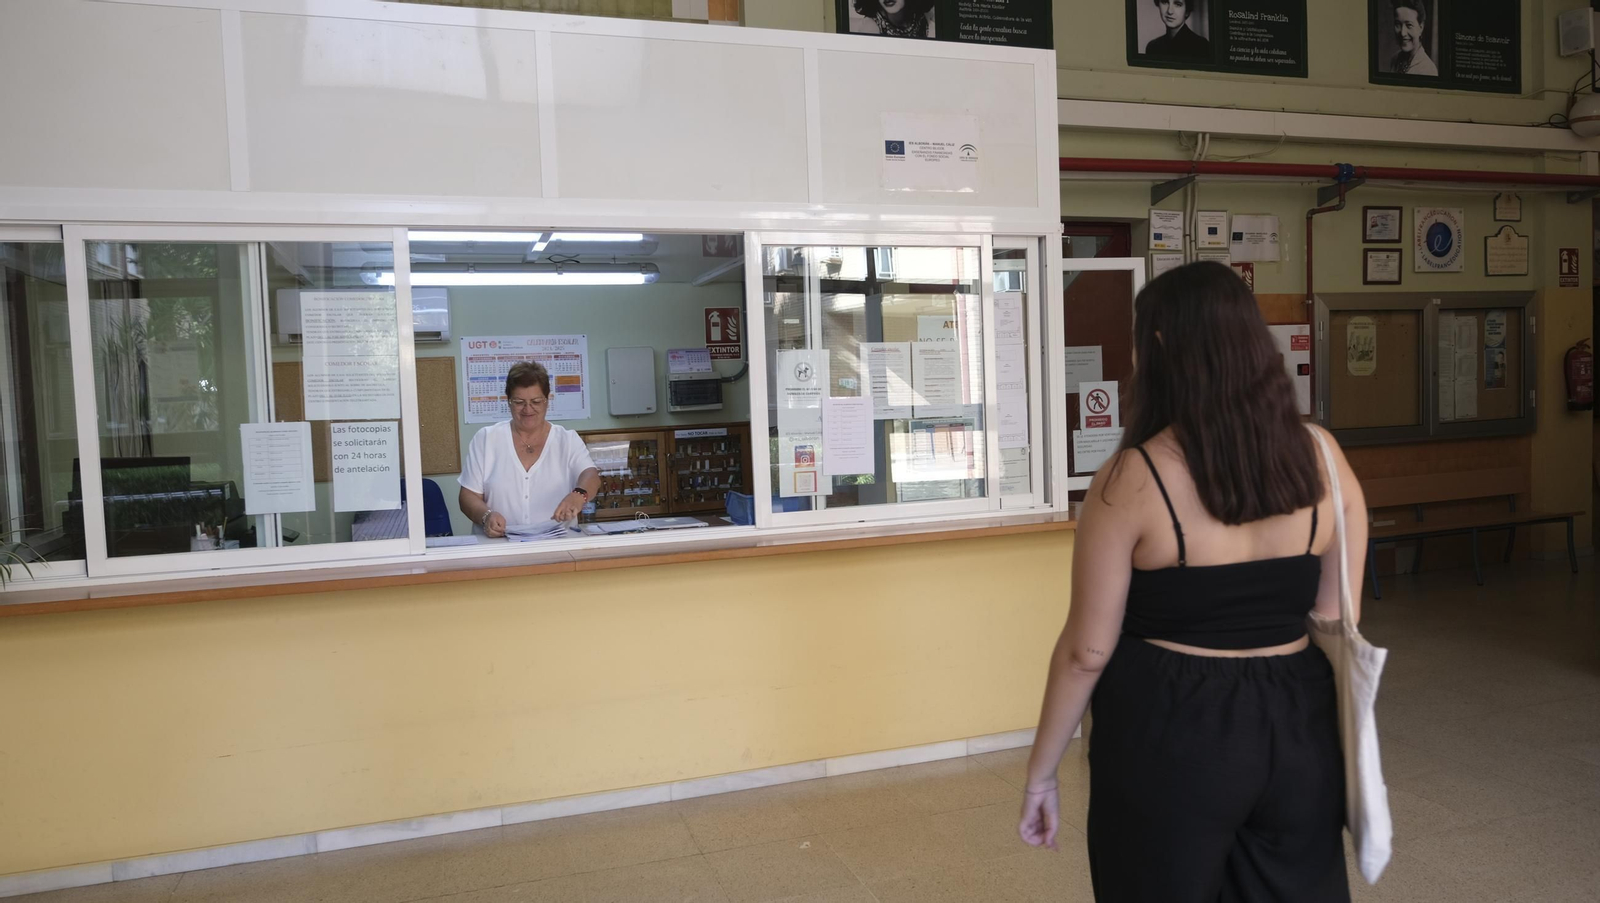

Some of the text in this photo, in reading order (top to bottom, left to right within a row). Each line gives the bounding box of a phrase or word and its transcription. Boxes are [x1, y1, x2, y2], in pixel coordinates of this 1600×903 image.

[1228, 10, 1259, 20] Rosalind
[1260, 13, 1289, 23] Franklin
[979, 25, 992, 34] gente
[468, 341, 487, 349] UGT
[348, 425, 392, 434] fotocopias
[344, 438, 387, 446] solicitarán
[347, 464, 390, 473] antelación
